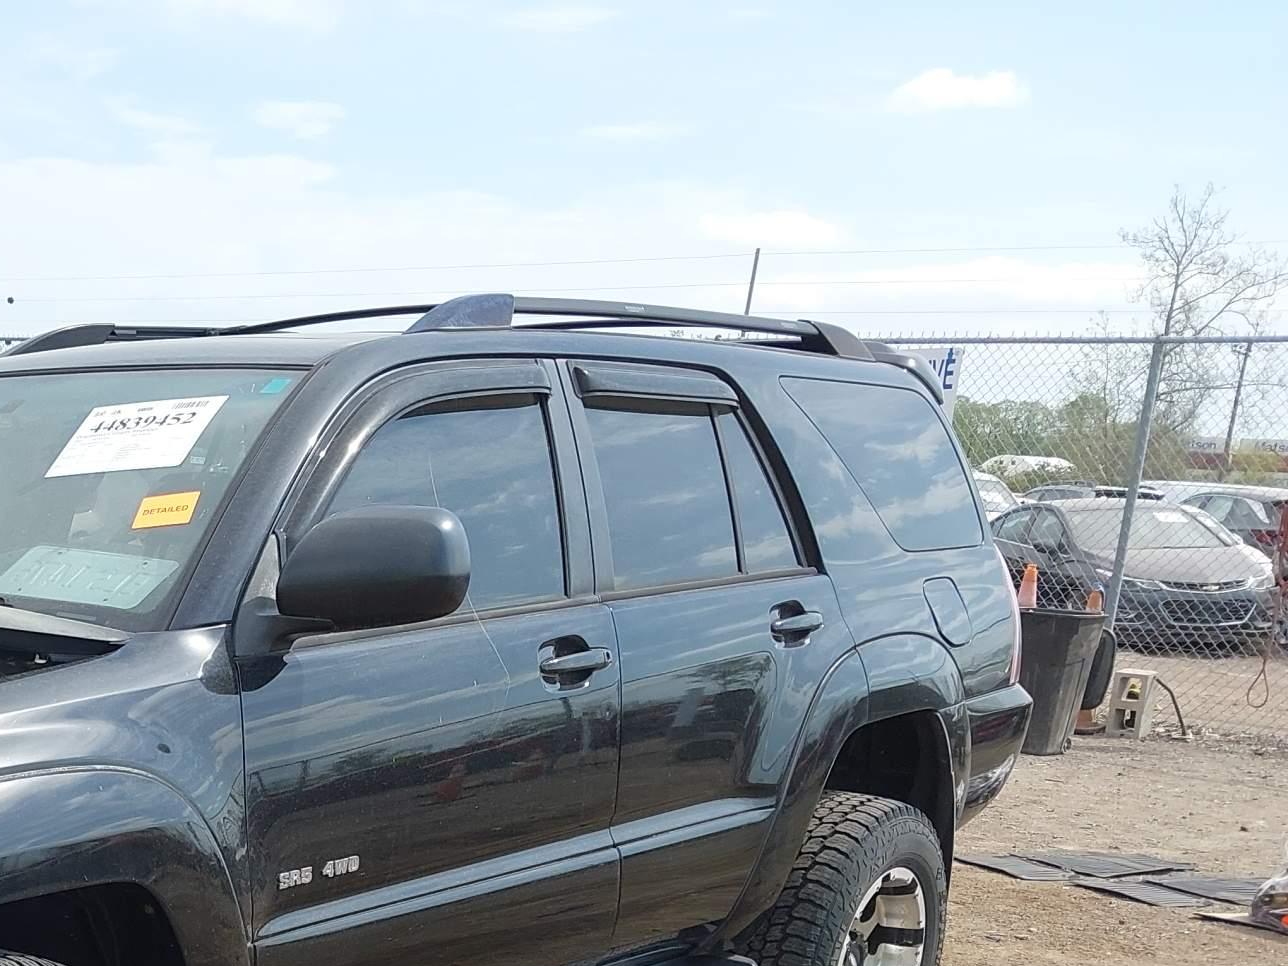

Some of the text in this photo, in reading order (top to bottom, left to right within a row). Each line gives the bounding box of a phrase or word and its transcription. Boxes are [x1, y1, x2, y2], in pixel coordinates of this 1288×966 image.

[90, 412, 197, 433] 44839452
[142, 504, 190, 517] DETAILED
[279, 855, 360, 890] SR5 4WD
